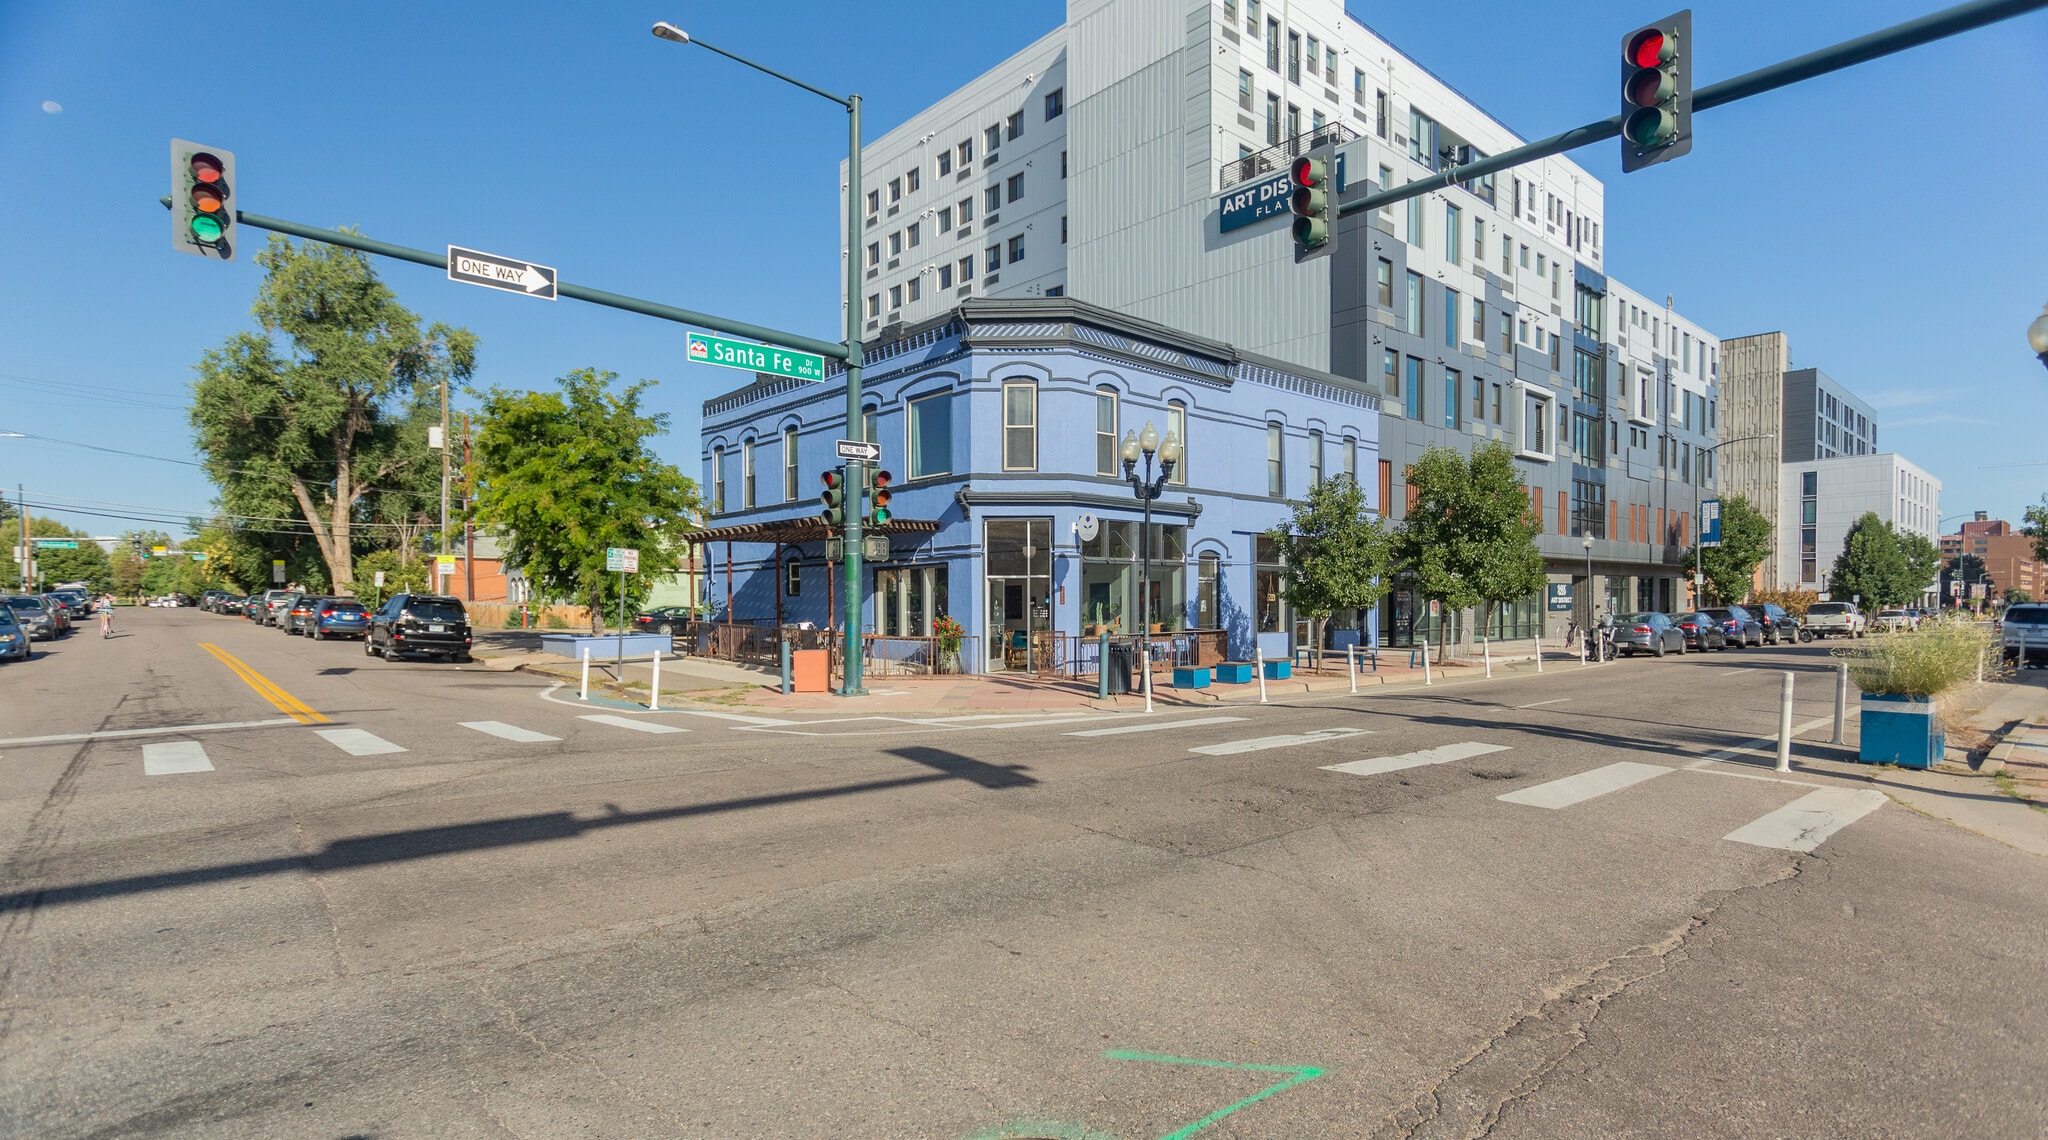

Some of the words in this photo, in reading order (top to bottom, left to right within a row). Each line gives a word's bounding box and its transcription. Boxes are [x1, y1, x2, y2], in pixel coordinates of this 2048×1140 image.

[1222, 189, 1256, 215] ART
[461, 259, 490, 277] ONE
[495, 266, 524, 283] WAY
[714, 343, 765, 368] Santa
[773, 353, 792, 372] Fe
[805, 359, 814, 367] Dr
[798, 366, 812, 375] 900
[814, 368, 821, 377] W
[841, 446, 854, 454] ONE
[855, 447, 868, 455] WAY
